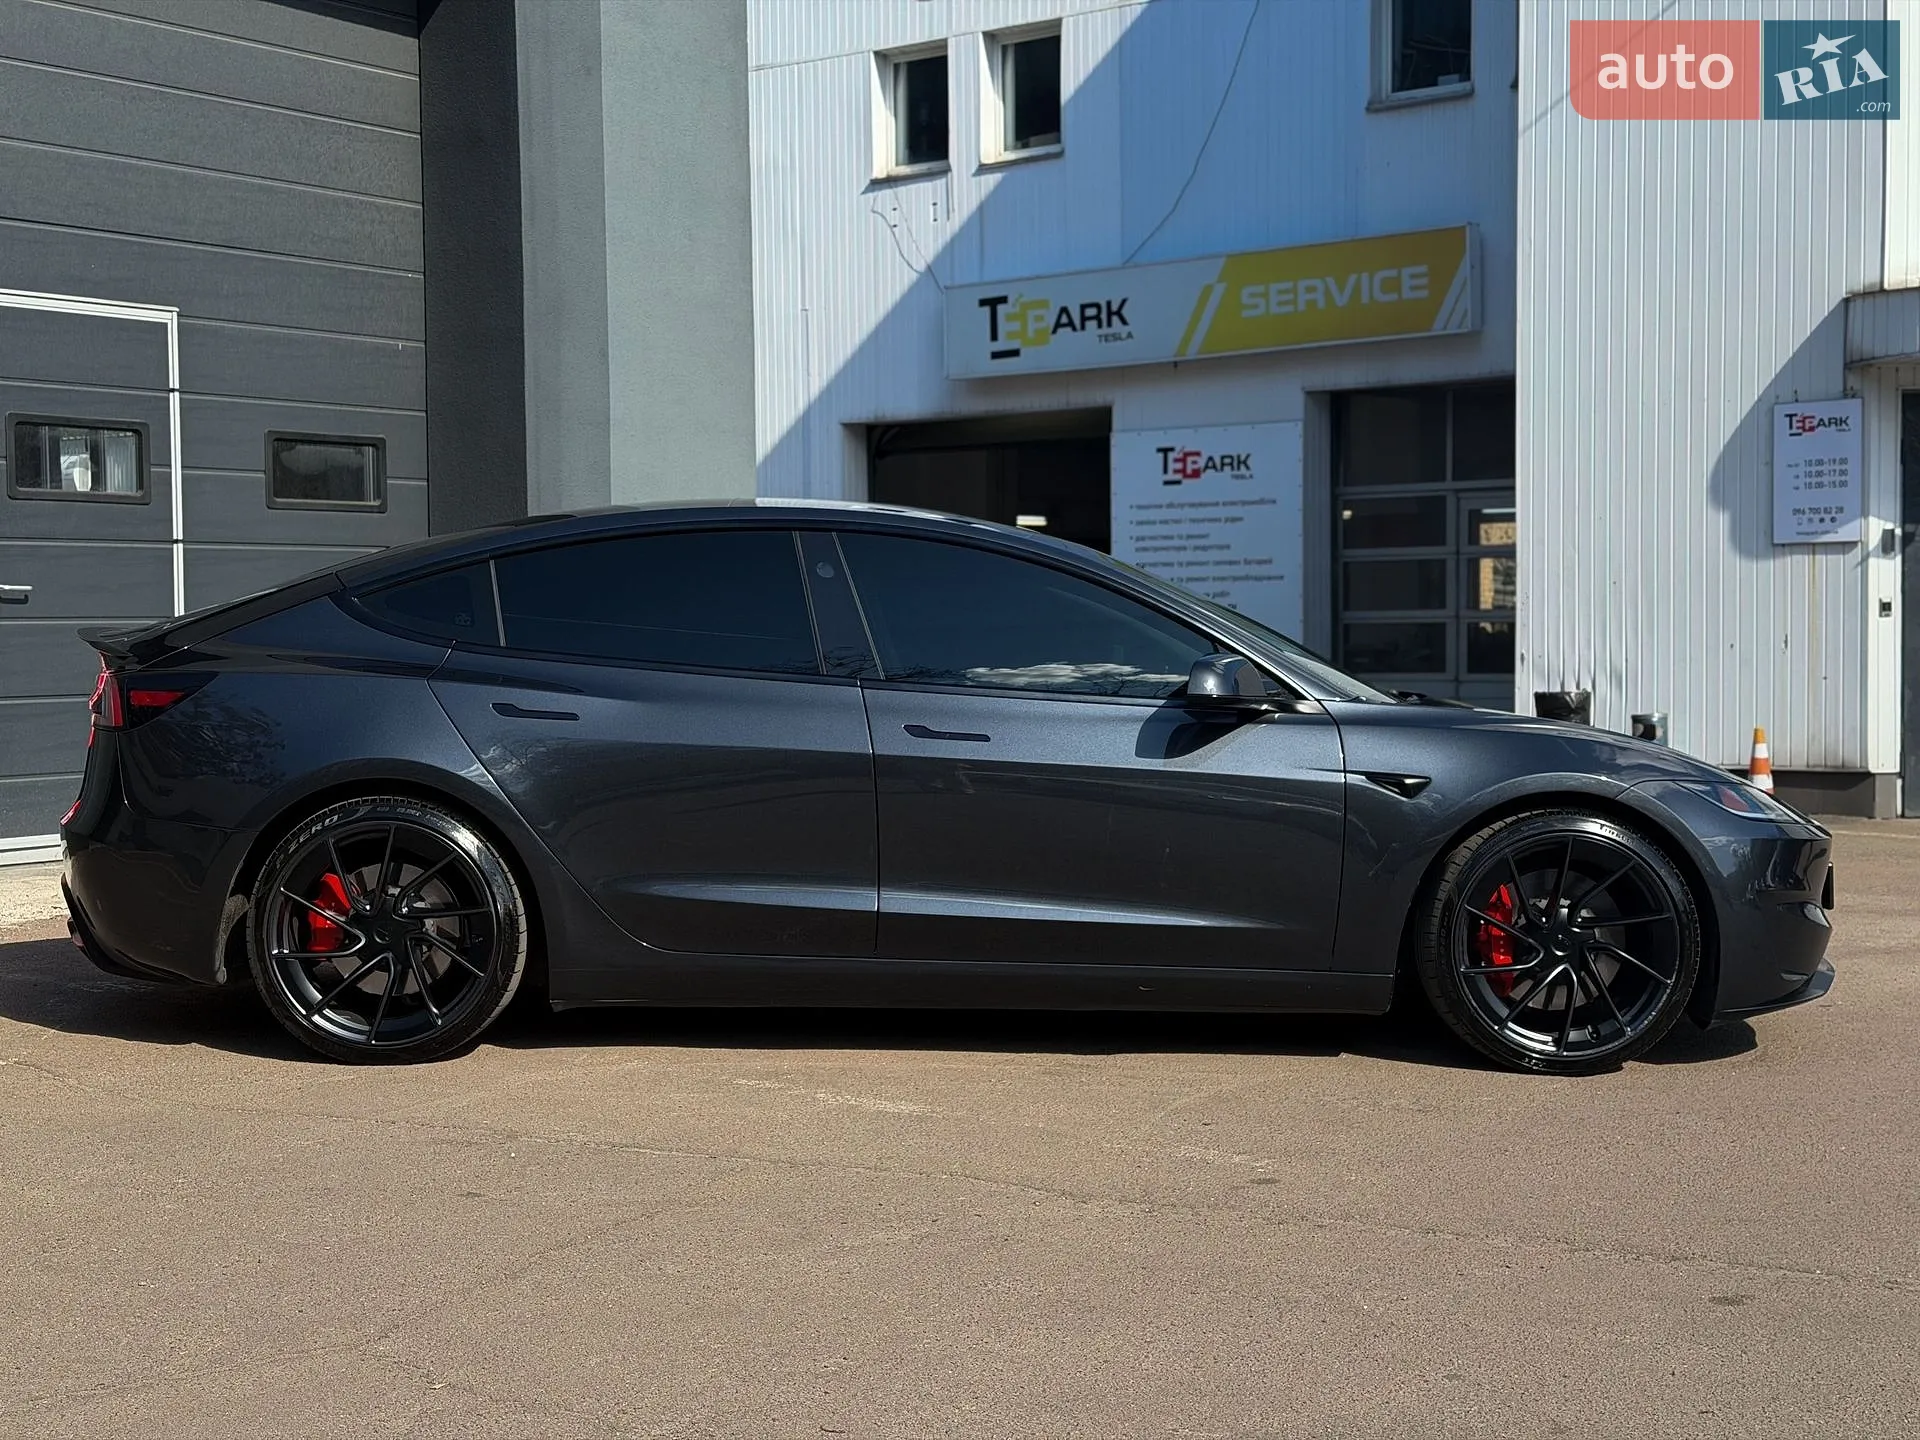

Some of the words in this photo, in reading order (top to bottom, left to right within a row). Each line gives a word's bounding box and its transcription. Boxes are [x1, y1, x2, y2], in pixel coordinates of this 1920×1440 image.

[1240, 264, 1430, 318] SERVICE
[1097, 330, 1135, 344] TESLA
[287, 813, 339, 855] ZERO
